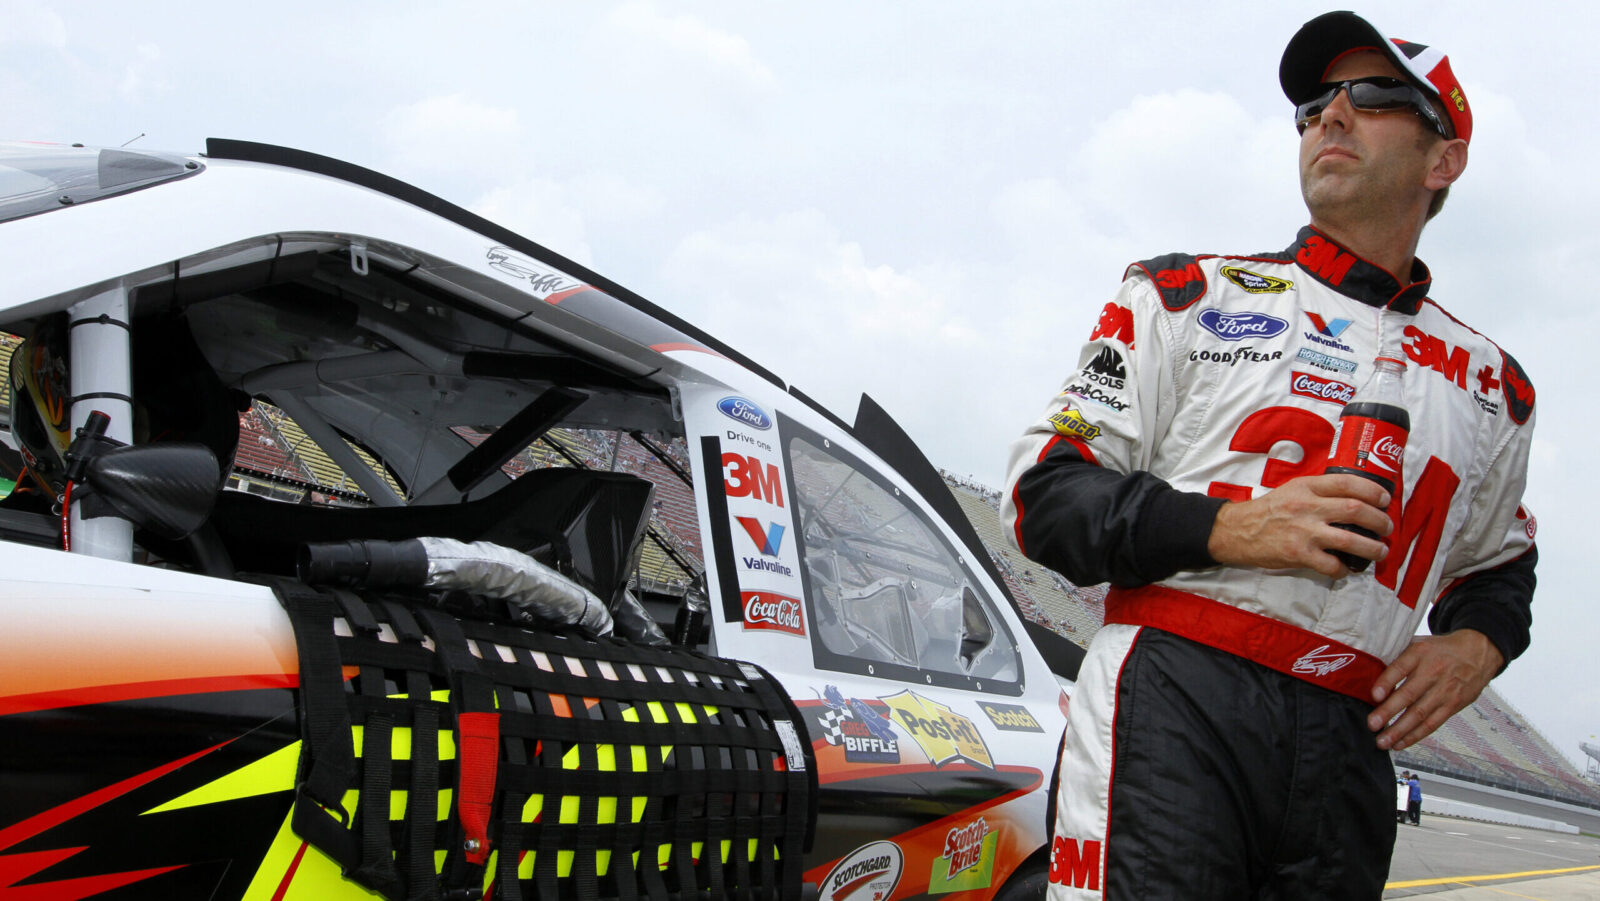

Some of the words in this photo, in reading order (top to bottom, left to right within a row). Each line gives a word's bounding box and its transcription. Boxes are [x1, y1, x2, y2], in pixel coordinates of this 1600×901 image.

[1449, 87, 1464, 112] 16
[1296, 236, 1357, 286] 3M
[1155, 263, 1202, 288] 3M
[1215, 315, 1268, 335] Ford
[1304, 332, 1351, 352] Valvoline
[1401, 325, 1470, 391] 3M
[1081, 371, 1125, 390] TOOLS
[1293, 374, 1354, 402] Coca-Cola
[731, 402, 763, 427] Ford
[727, 430, 755, 445] Drive
[757, 441, 772, 452] one
[721, 452, 784, 508] 3M
[743, 557, 792, 577] Valvoline
[744, 595, 800, 628] Coca-Cola
[896, 708, 979, 745] Post-it
[985, 706, 1038, 728] Scotch
[845, 737, 898, 753] BIFFLE
[832, 855, 891, 892] SCOTCHGARD
[947, 844, 981, 880] Brite
[1049, 836, 1100, 890] 3M
